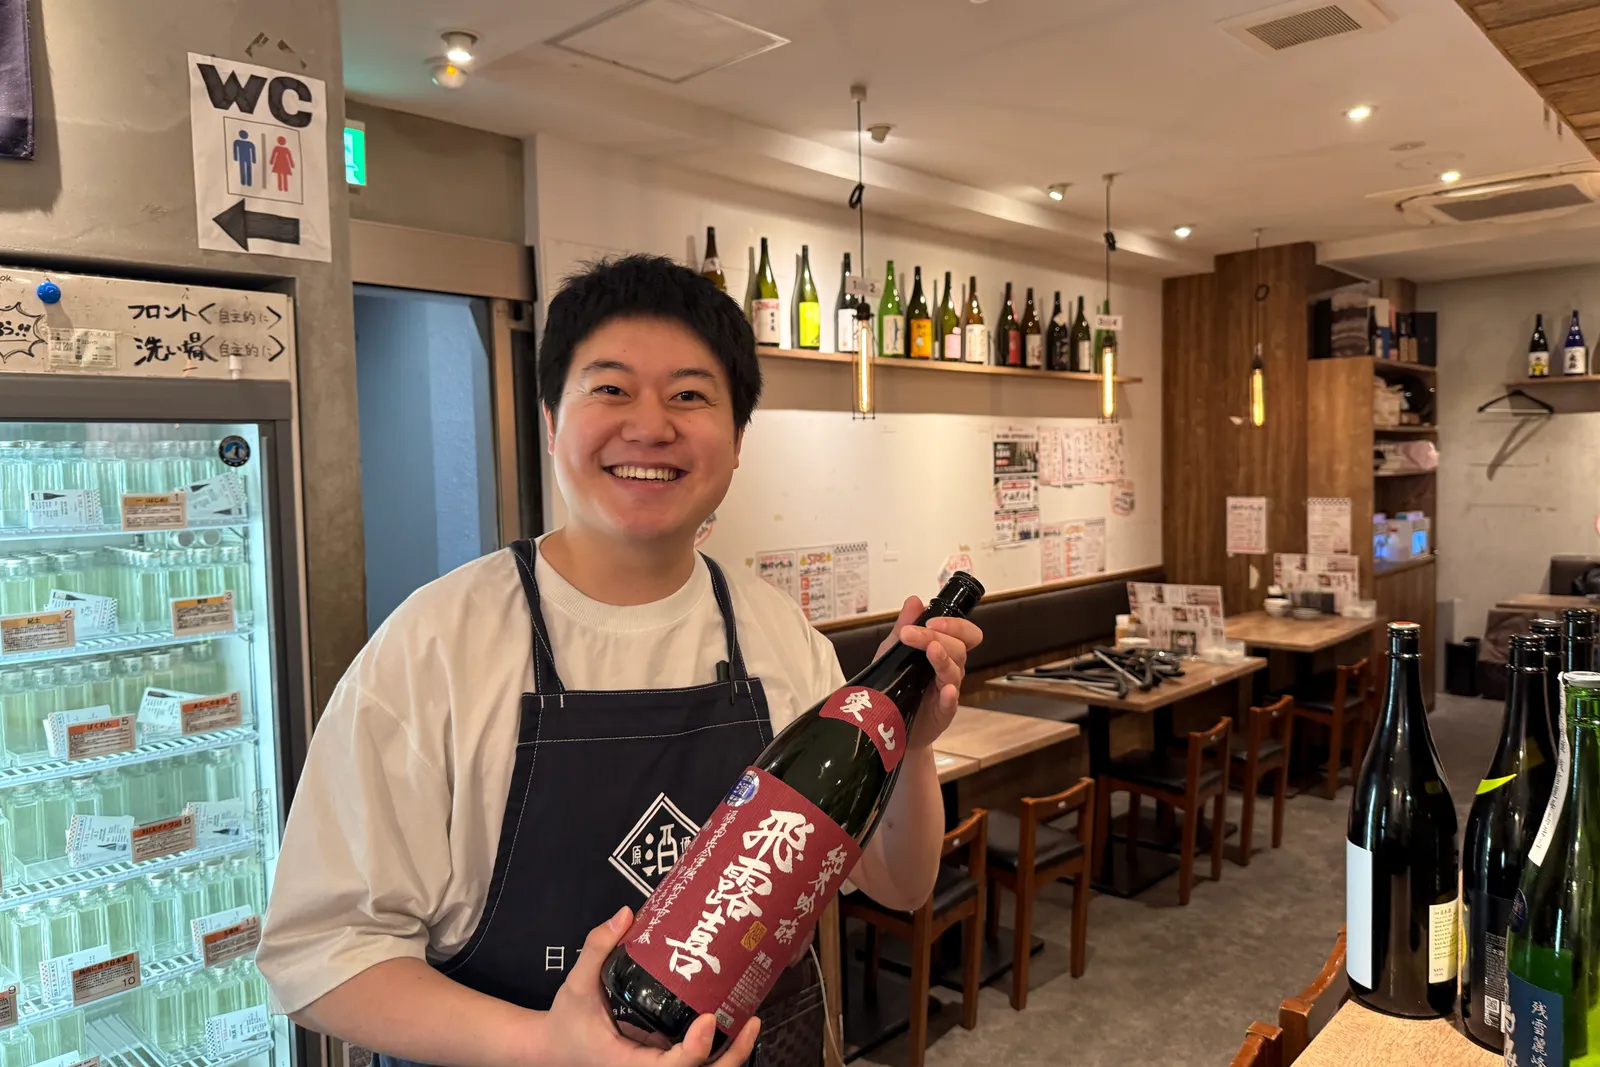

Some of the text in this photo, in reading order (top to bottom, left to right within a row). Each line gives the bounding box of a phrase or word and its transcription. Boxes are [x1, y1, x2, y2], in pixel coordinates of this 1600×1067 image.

[196, 63, 313, 128] WC
[870, 284, 876, 293] 2
[226, 591, 233, 600] 3
[64, 609, 72, 619] 2
[231, 692, 237, 702] 6
[121, 716, 129, 726] 5
[665, 809, 815, 982] 飛露喜
[123, 976, 136, 987] 10
[8, 985, 17, 995] 9
